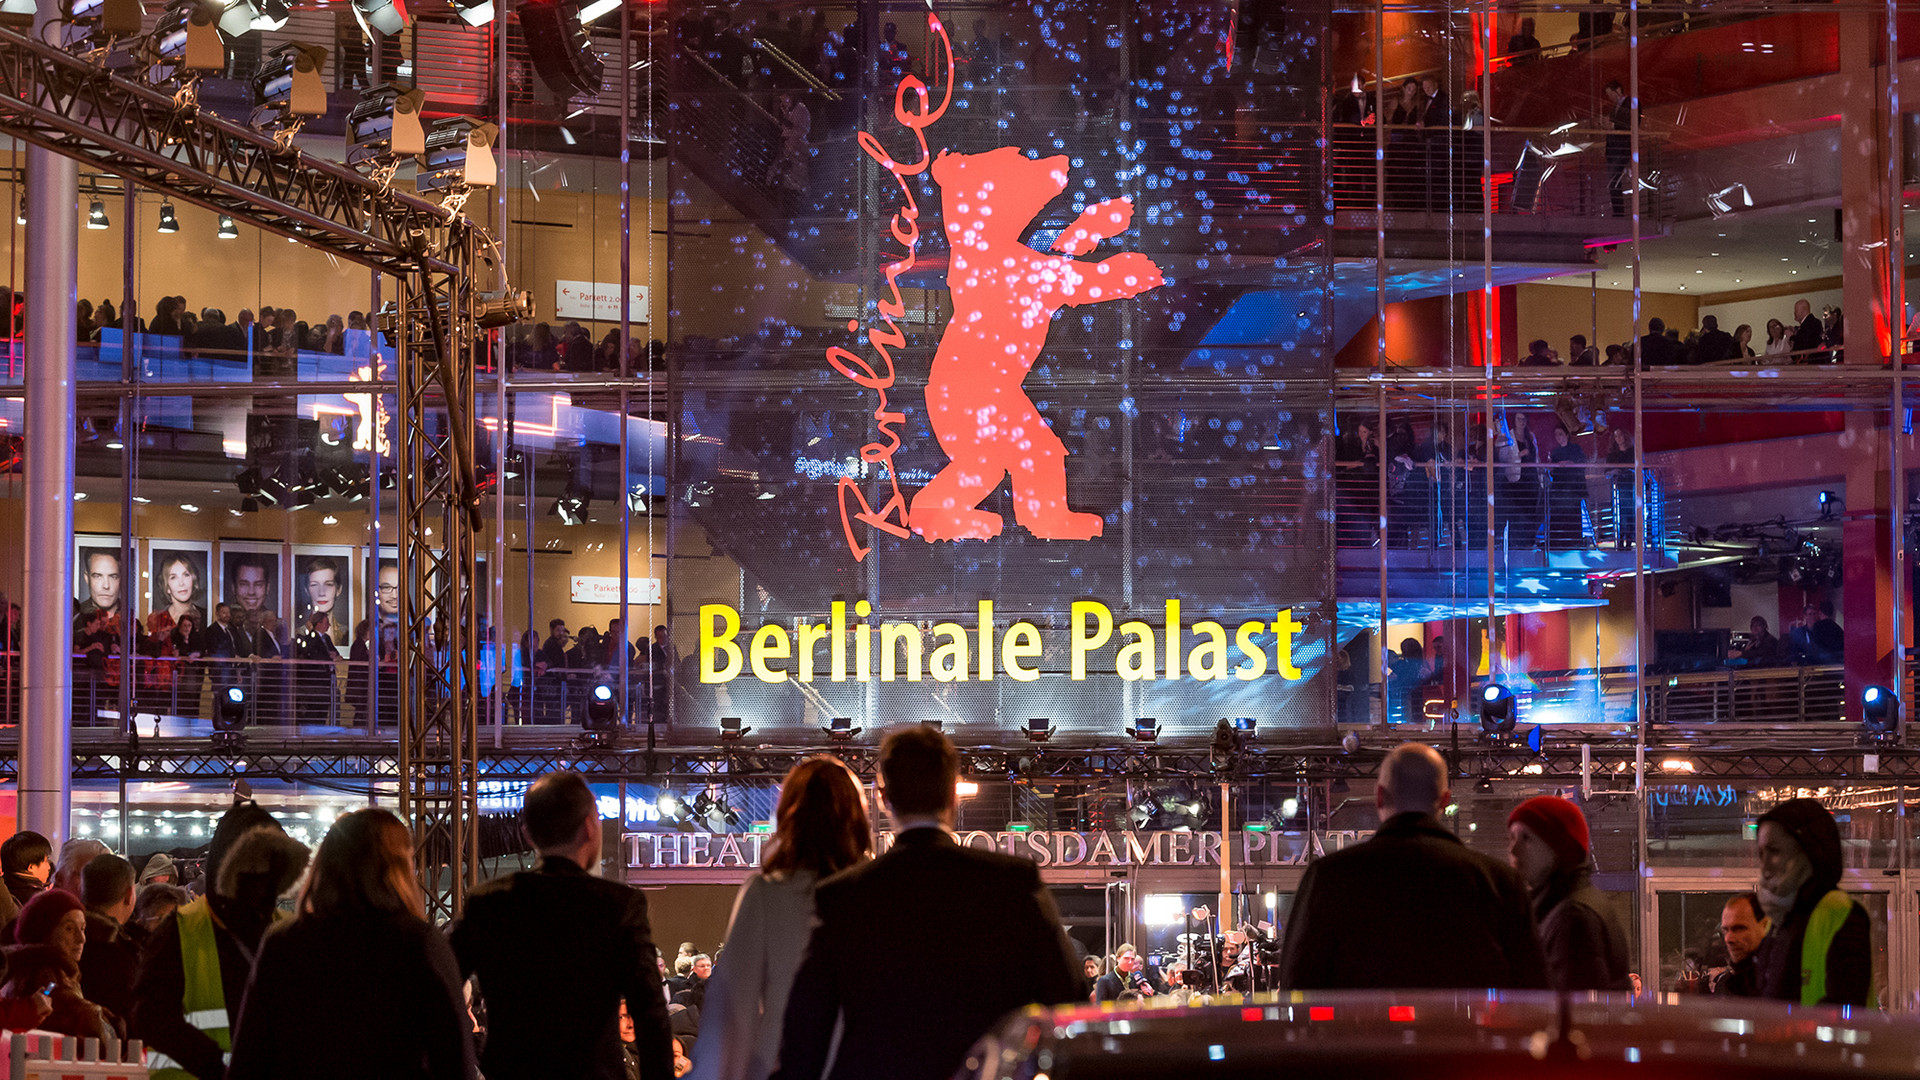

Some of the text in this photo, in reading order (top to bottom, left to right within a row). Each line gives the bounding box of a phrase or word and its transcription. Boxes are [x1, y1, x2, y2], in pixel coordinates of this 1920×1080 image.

[579, 292, 607, 302] Parett
[826, 12, 955, 562] Berlinale
[593, 583, 621, 593] Parket
[699, 599, 1303, 684] Berlinale Palast
[621, 830, 1376, 868] THEAT OTSDAMER PLAT
